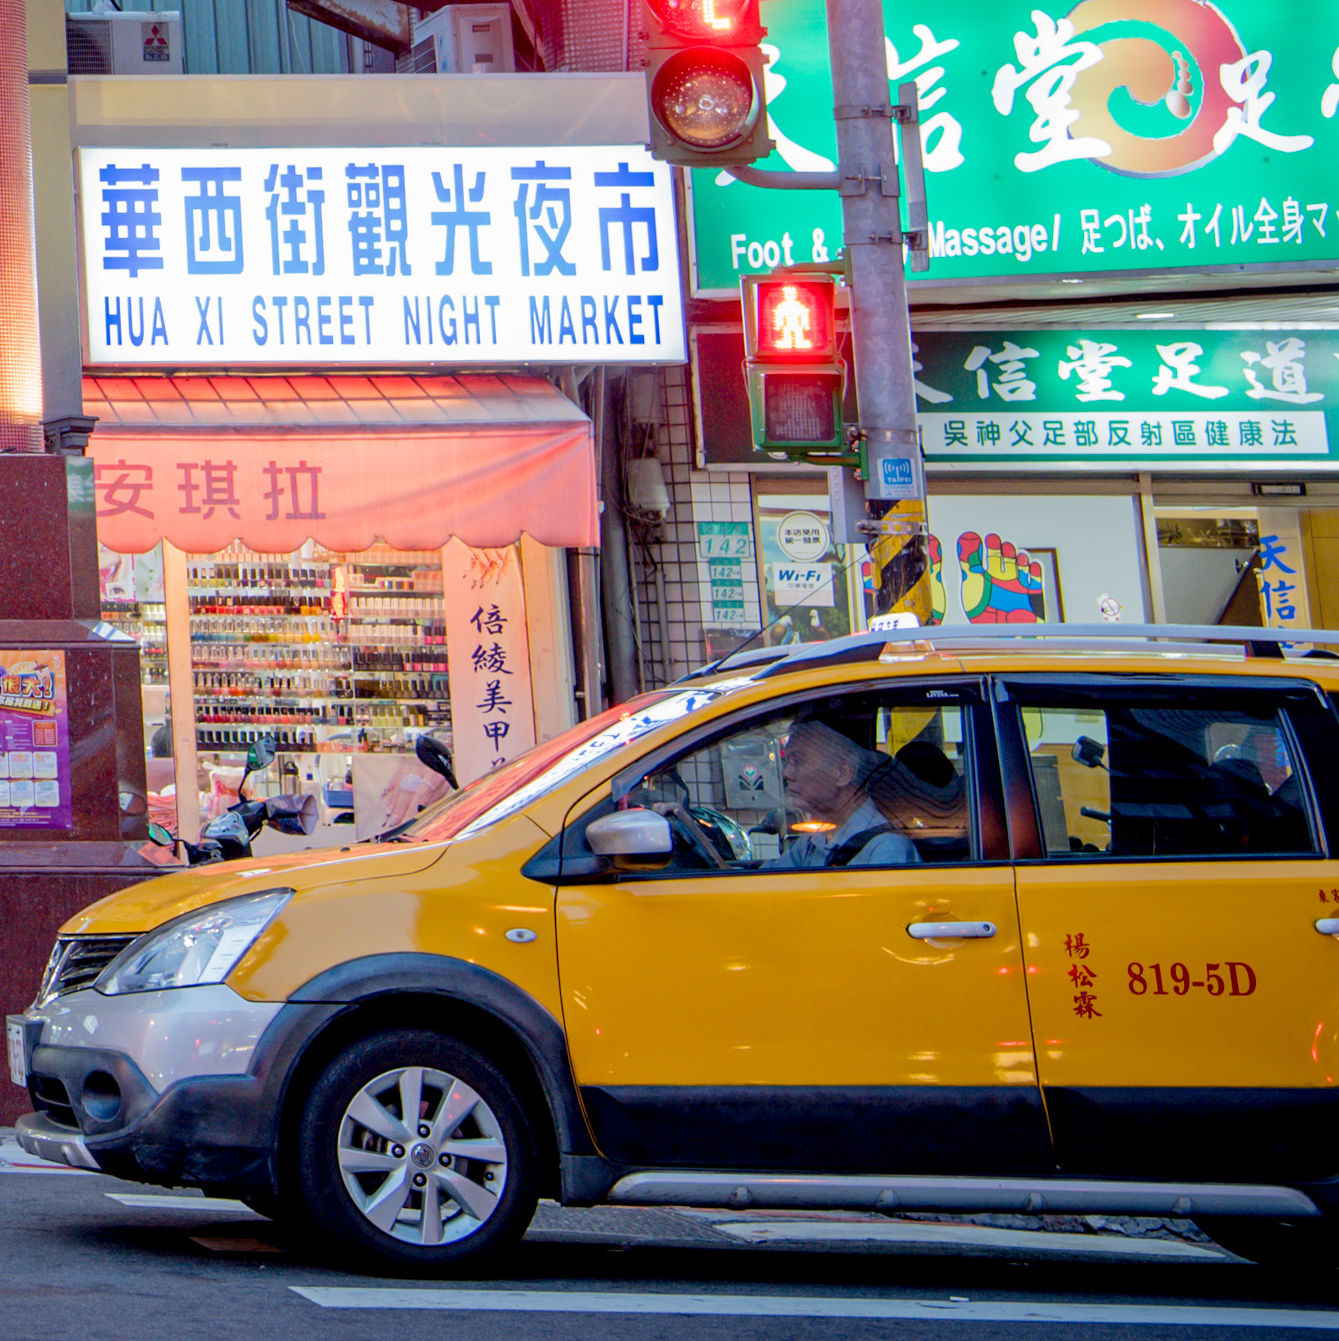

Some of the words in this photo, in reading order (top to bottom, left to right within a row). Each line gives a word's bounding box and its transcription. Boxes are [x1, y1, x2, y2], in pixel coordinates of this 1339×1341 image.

[715, 10, 1339, 187] 信堂足
[99, 161, 661, 278] 華西街觀光夜市
[730, 231, 795, 269] Foot
[811, 227, 830, 263] &
[105, 295, 169, 347] HUA
[197, 295, 226, 347] XI
[253, 295, 376, 347] STREET
[405, 295, 501, 346] NIGHT
[530, 294, 664, 346] MARKET
[95, 459, 327, 521] 安琪拉
[705, 538, 747, 555] 142
[779, 570, 821, 582] Wi-Fi
[469, 603, 514, 769] 倍綾美甲
[1126, 962, 1257, 997] 819-5D
